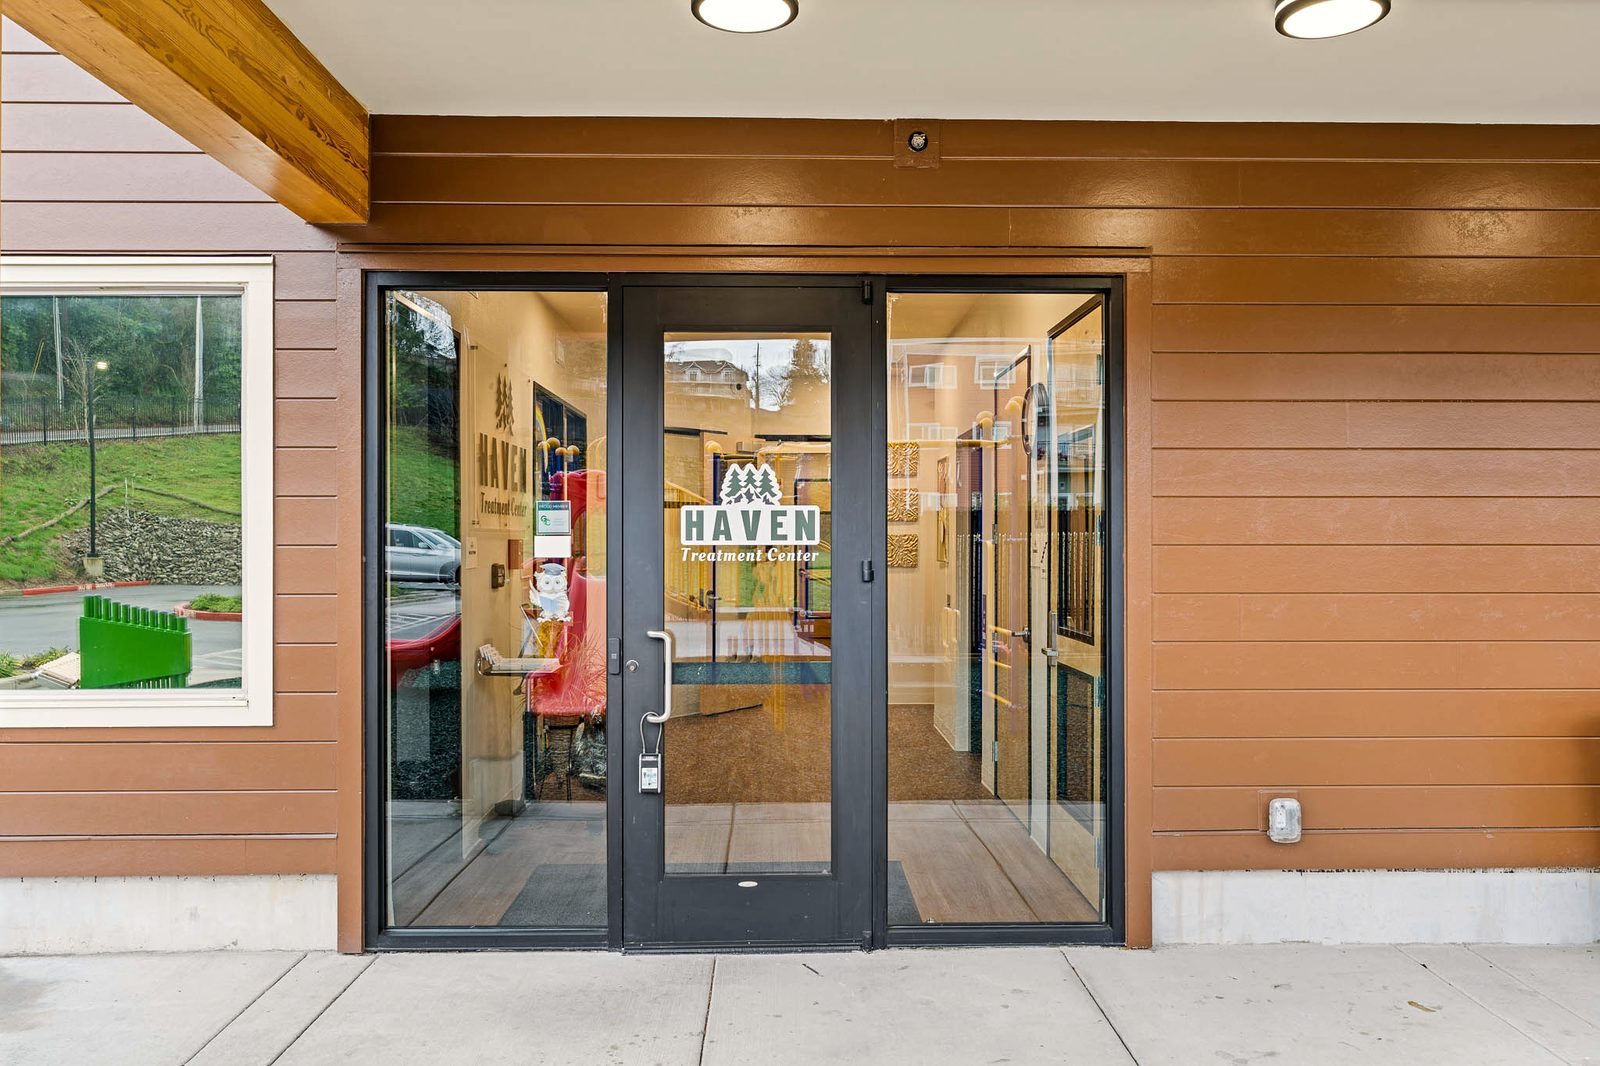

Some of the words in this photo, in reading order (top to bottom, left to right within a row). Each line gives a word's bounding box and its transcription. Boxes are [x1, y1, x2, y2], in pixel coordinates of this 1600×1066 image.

[479, 432, 527, 493] HAVEN
[481, 492, 510, 515] Treatment
[685, 510, 816, 541] HAVEN
[681, 547, 763, 562] Treatment
[767, 547, 819, 562] Center
